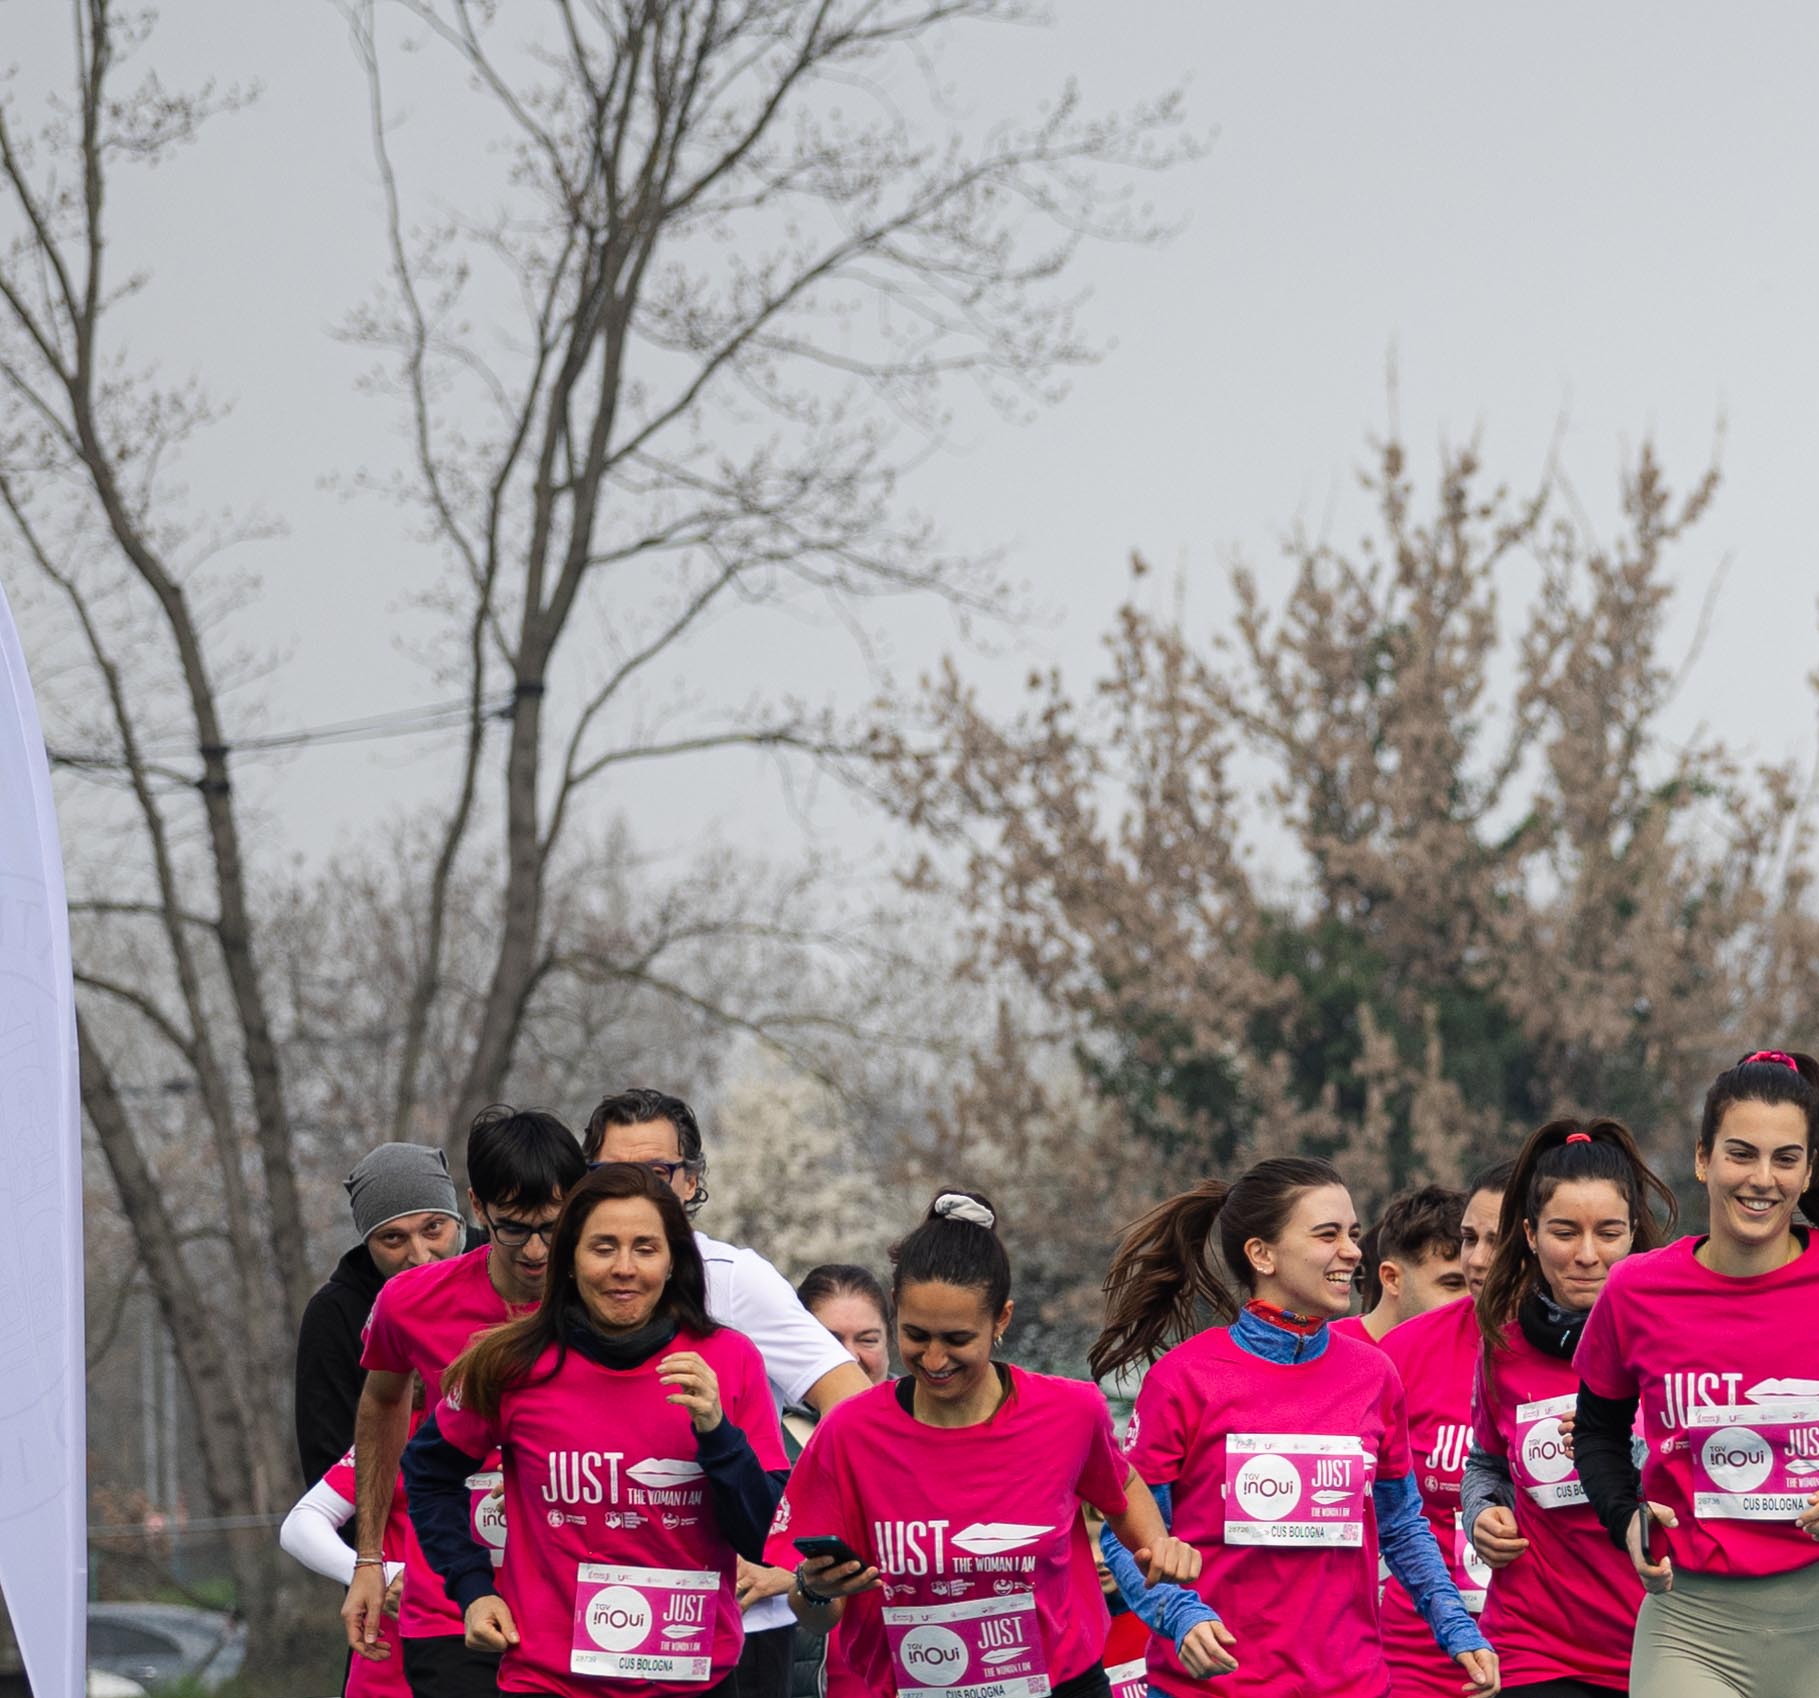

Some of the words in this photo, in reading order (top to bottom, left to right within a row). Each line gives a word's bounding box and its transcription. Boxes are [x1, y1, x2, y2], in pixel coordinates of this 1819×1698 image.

[1660, 1373, 1743, 1429] JUST
[542, 1451, 624, 1504] JUST
[1312, 1460, 1352, 1487] JUST
[628, 1488, 647, 1505] THE
[1556, 1486, 1572, 1498] CUS
[1743, 1498, 1760, 1510] CUS
[1762, 1498, 1804, 1510] BOLOGNA
[1271, 1526, 1288, 1538] CUS
[1289, 1526, 1324, 1538] BOLOGNA
[875, 1520, 949, 1576] JUST
[953, 1557, 974, 1573] THE
[975, 1557, 1013, 1572] WOMAN
[1021, 1556, 1036, 1572] AM
[595, 1603, 610, 1611] TGV
[663, 1595, 706, 1622] JUST
[978, 1617, 1024, 1649] JUST
[619, 1657, 635, 1670] CUS
[636, 1658, 673, 1672] BOLOGNA
